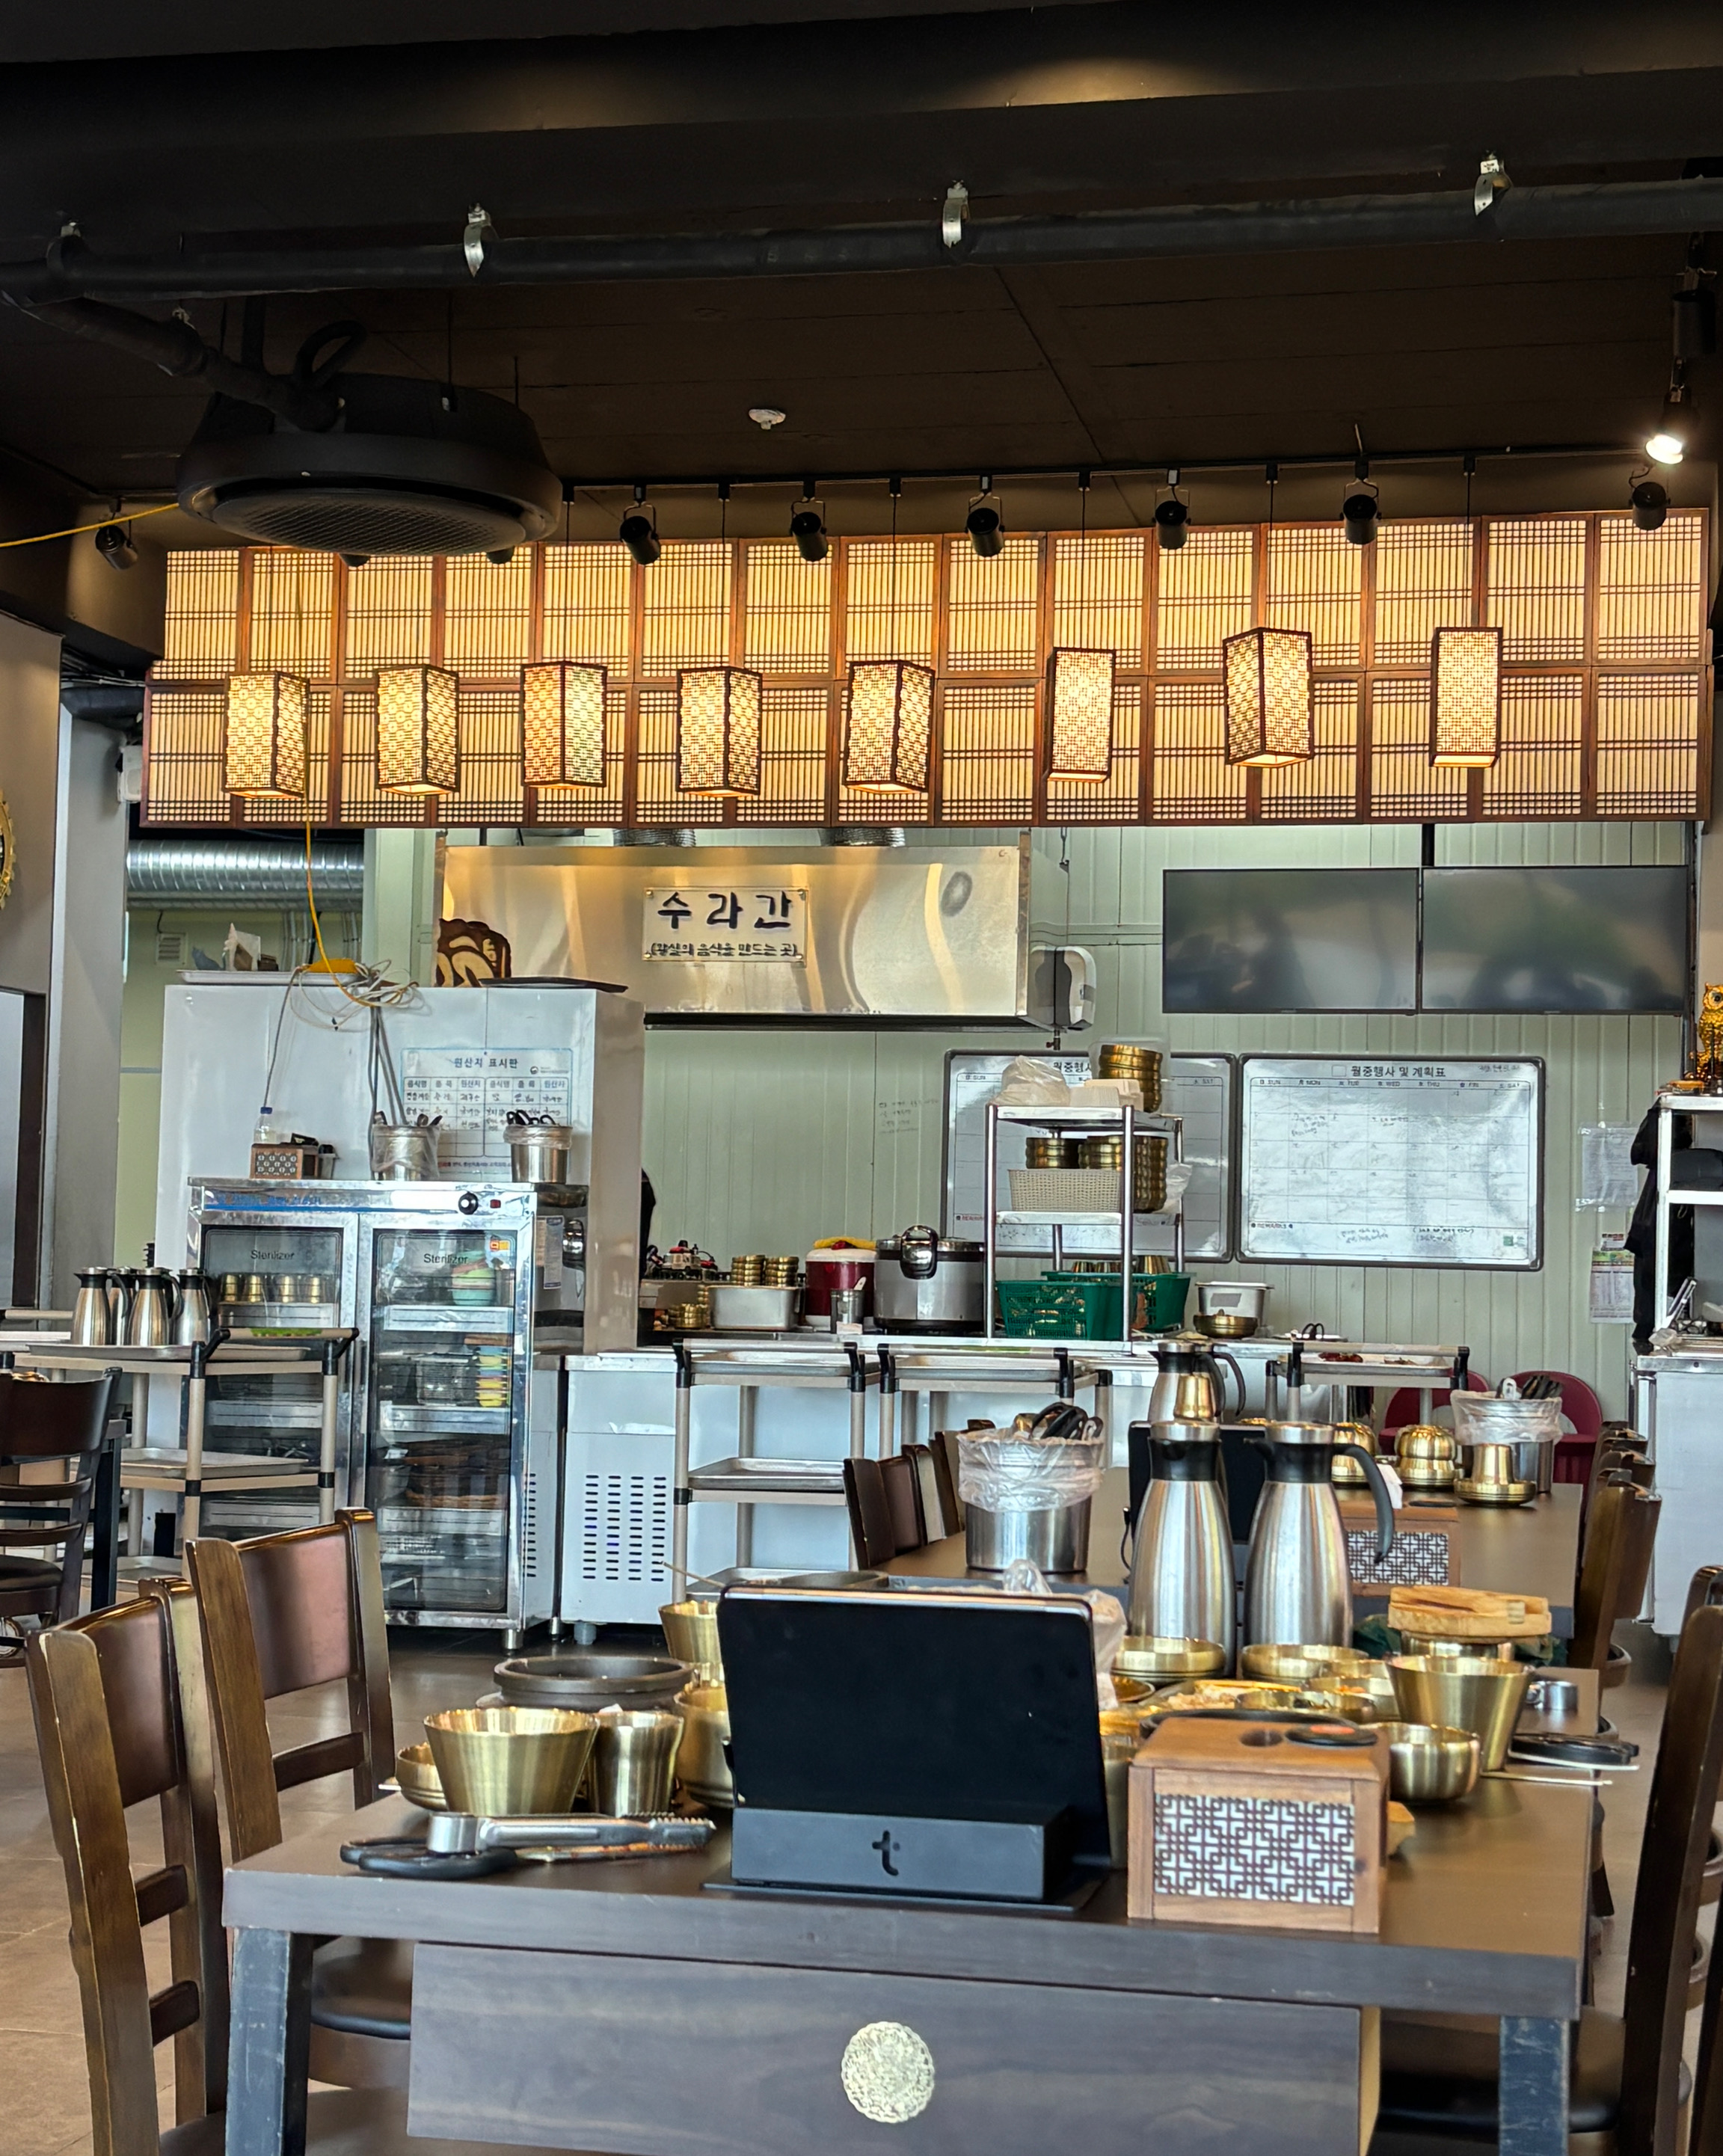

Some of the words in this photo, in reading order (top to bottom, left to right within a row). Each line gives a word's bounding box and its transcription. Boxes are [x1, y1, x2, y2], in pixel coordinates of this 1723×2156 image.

[657, 891, 793, 930] 수라간
[697, 943, 735, 956] 음식을
[738, 943, 777, 956] 만드는
[454, 1057, 483, 1069] 원산지
[488, 1057, 518, 1069] 표시판
[1351, 1065, 1395, 1077] 월중행사
[1399, 1066, 1409, 1077] 및
[1412, 1066, 1446, 1078] 계획표
[251, 1250, 295, 1260] Sterilizer
[423, 1253, 468, 1264] Sterilizer
